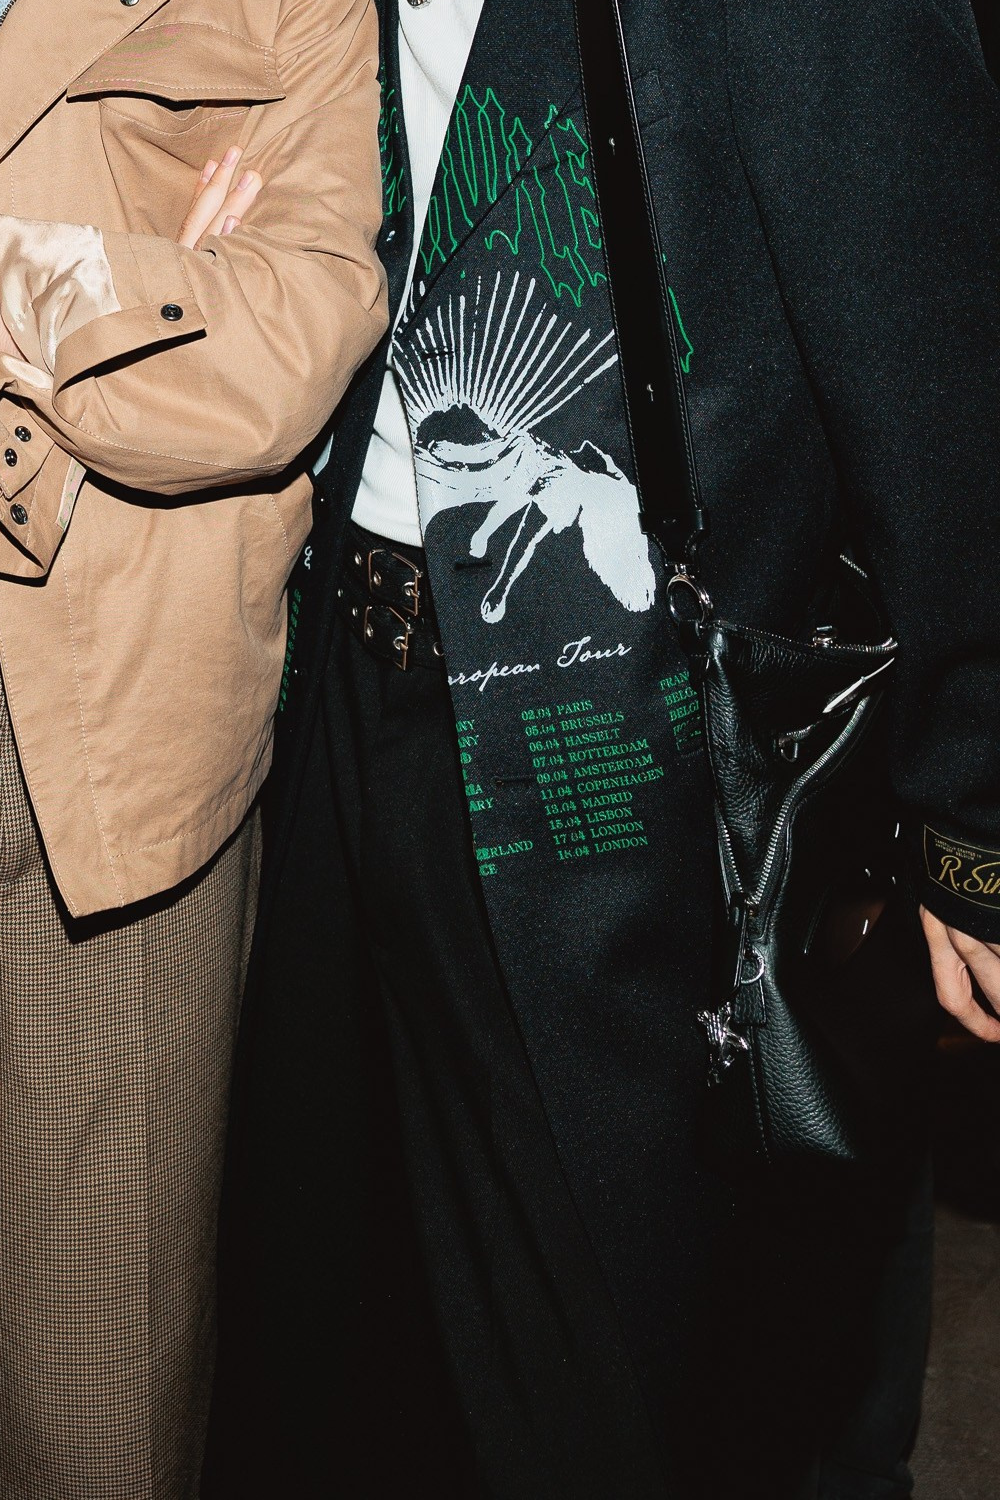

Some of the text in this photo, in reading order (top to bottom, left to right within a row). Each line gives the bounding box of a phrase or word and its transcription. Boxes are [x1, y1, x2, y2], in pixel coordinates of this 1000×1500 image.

[557, 636, 632, 668] Tour
[556, 700, 593, 715] PARIS
[559, 711, 625, 731] BRUSSELS
[564, 728, 620, 747] HASSELT
[568, 738, 649, 763] ROTTERDAM
[536, 753, 654, 784] 09.04 AMSTERDAM
[540, 766, 665, 800] 11.04 COPENHAGEN
[581, 791, 633, 809] MADRID
[585, 807, 633, 824] LISBON
[590, 821, 644, 839] LONDON
[595, 836, 649, 854] LONDON
